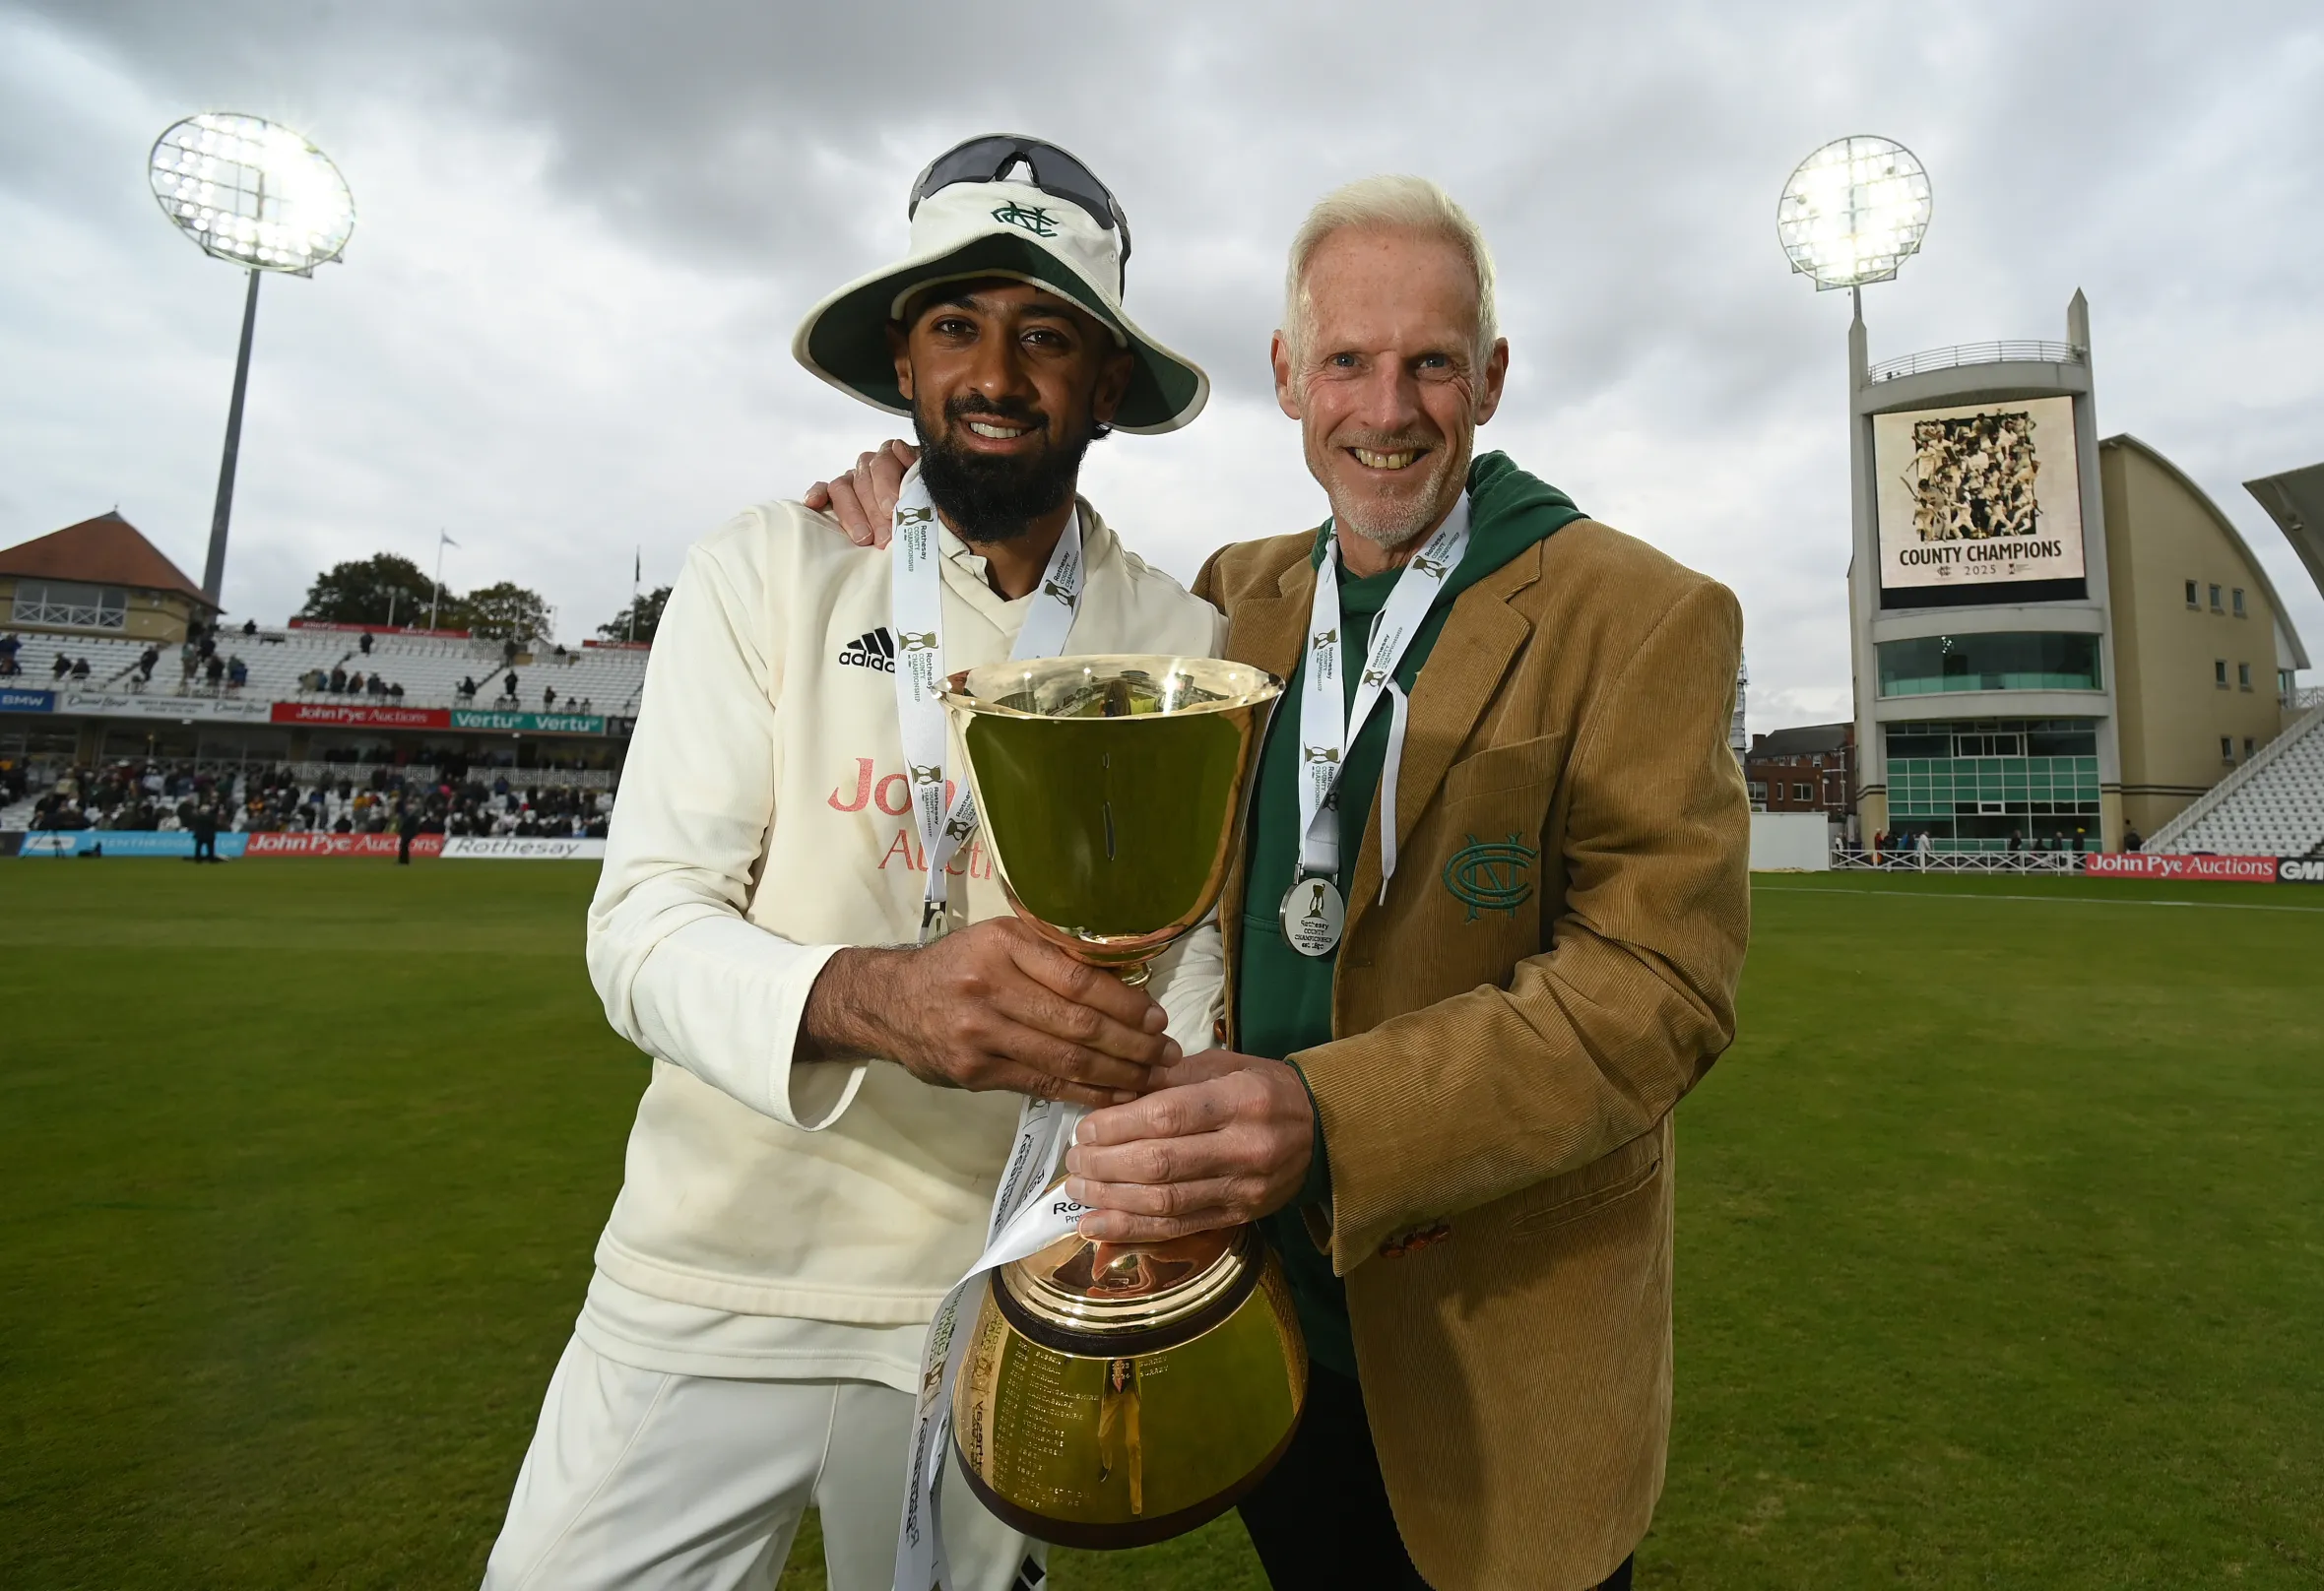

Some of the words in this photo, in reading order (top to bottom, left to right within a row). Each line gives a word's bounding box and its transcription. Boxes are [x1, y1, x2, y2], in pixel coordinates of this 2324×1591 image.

[1424, 531, 1447, 557] Rothesay
[1432, 542, 1447, 559] COUNTY
[1900, 546, 1962, 565] COUNTY
[1967, 541, 2062, 562] CHAMPIONS
[1054, 551, 1070, 581] Rothesay
[1060, 563, 1070, 584] COUNTY
[1964, 564, 1997, 576] 2025
[839, 650, 895, 673] adida
[1372, 633, 1390, 668] Rothesay
[912, 654, 921, 702] CHAMPIONSHIP
[2, 694, 44, 707] BMW
[295, 706, 336, 720] John
[338, 708, 367, 724] Pye
[368, 709, 429, 723] Auctions
[457, 713, 517, 729] Vertu
[535, 716, 592, 732] Vertu
[956, 791, 971, 817] Rothe
[248, 834, 308, 851] John
[309, 835, 352, 856] Pye
[355, 835, 439, 853] Auctons
[457, 837, 581, 859] Rothesay
[2090, 855, 2143, 871] John
[2147, 856, 2183, 876] Pye
[2186, 858, 2274, 875] Auctions
[2280, 860, 2324, 880] GM
[930, 1307, 949, 1361] COUNTY
